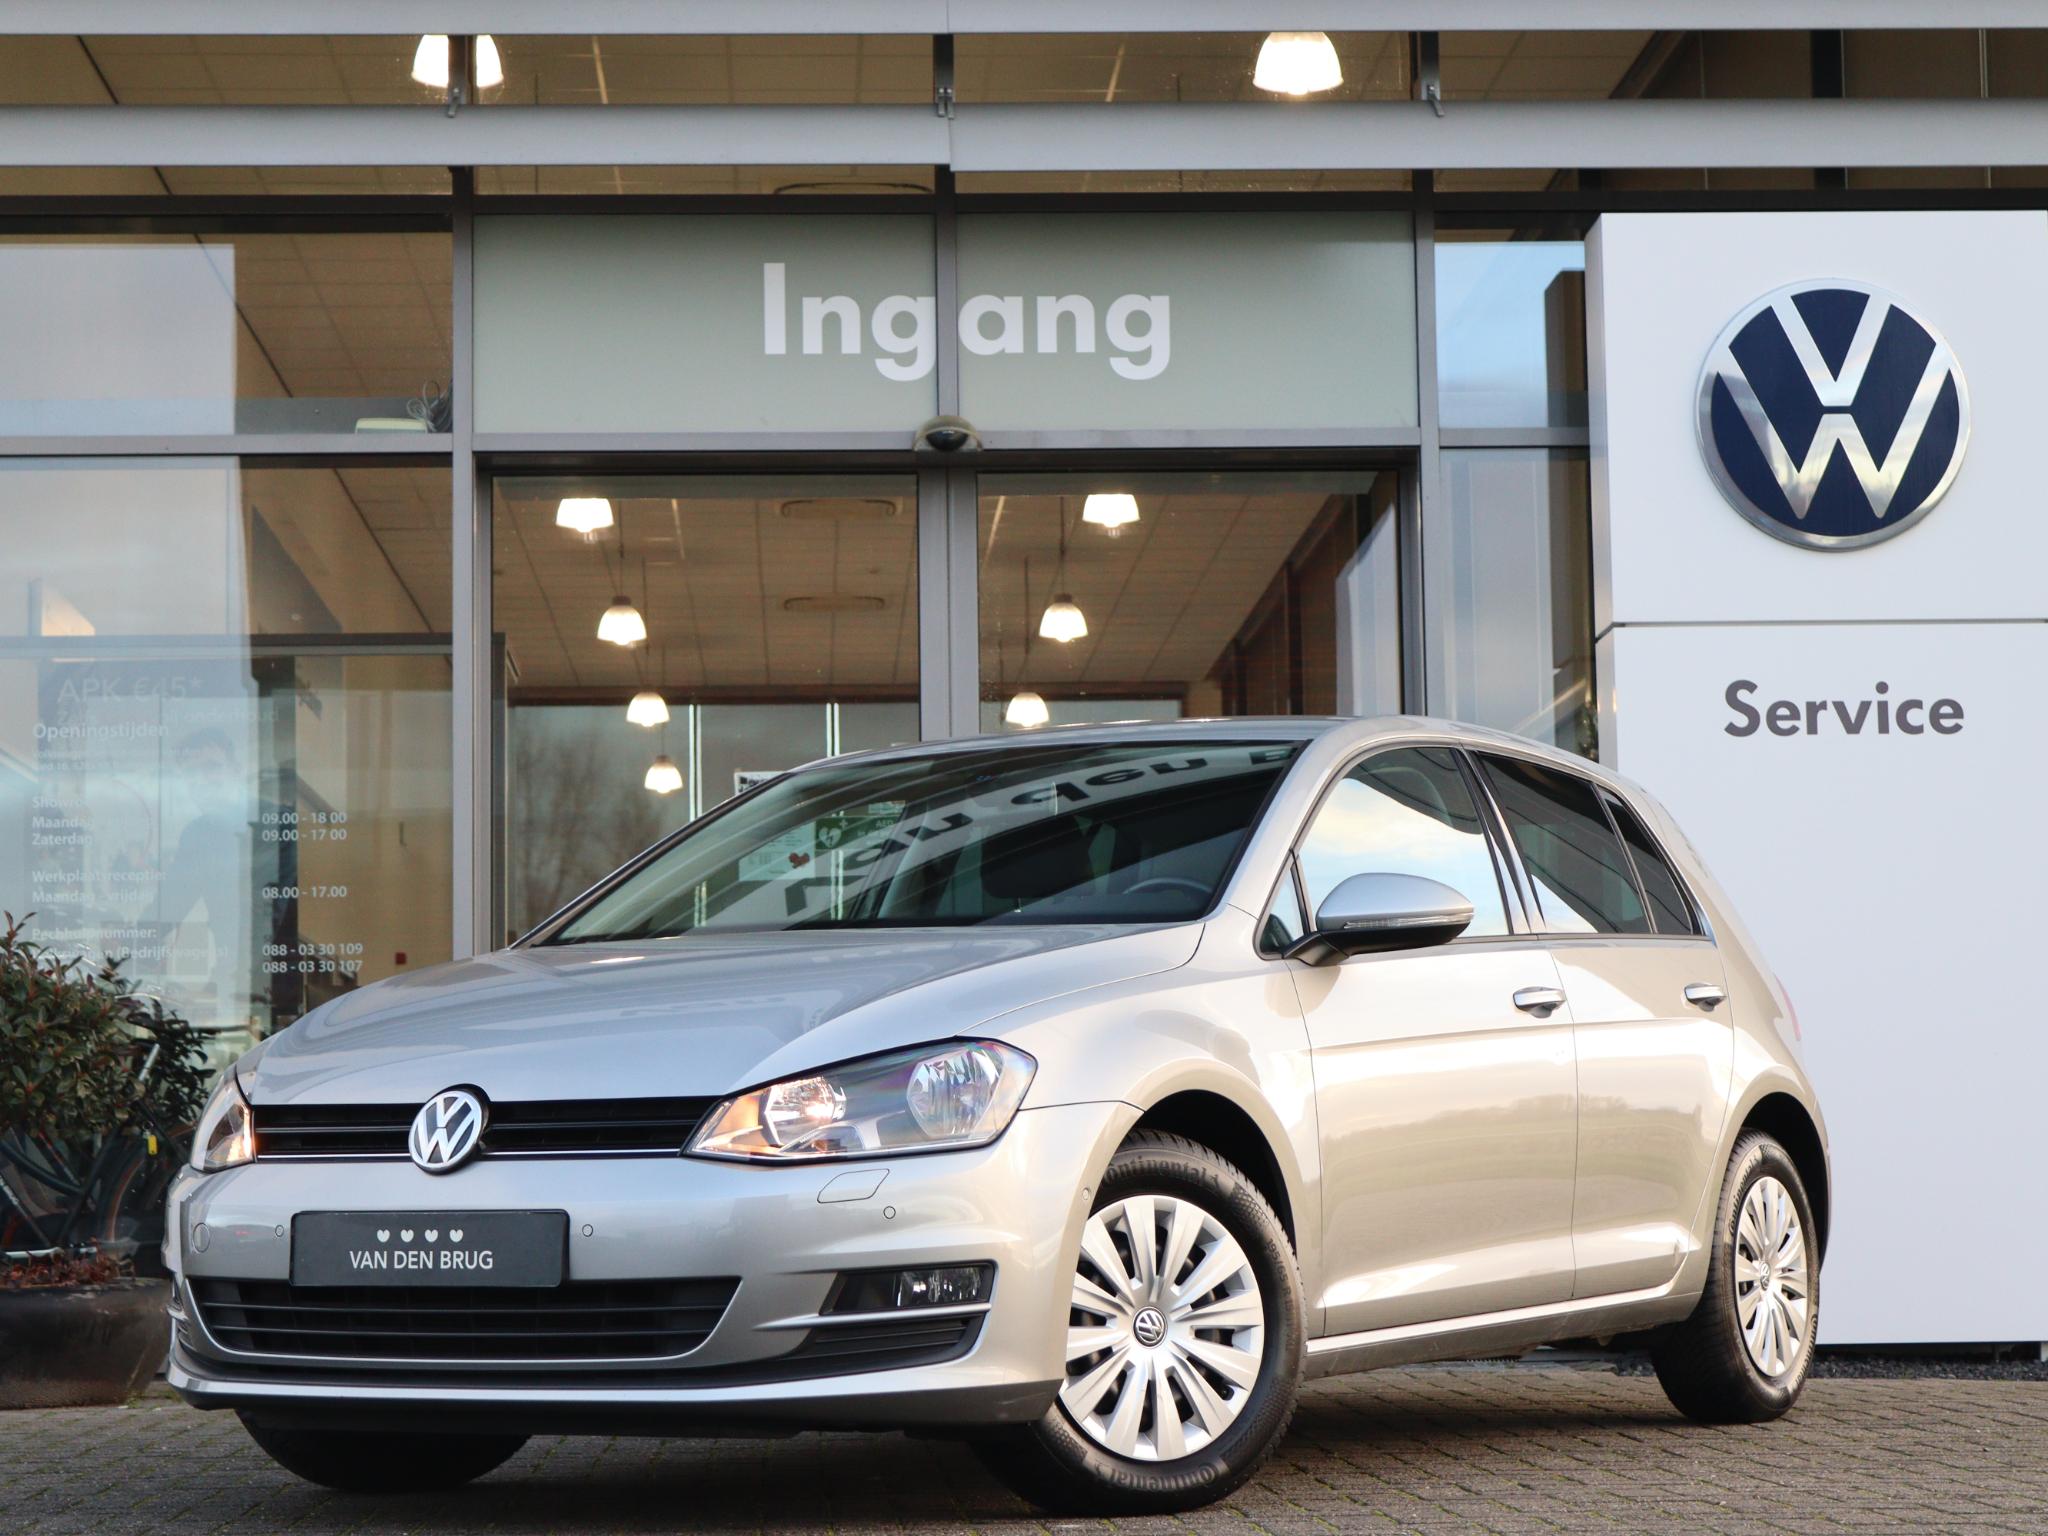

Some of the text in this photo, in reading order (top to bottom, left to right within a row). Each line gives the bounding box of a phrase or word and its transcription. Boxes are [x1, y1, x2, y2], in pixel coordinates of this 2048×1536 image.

[763, 262, 1171, 381] Ingang
[57, 678, 121, 703] APK
[1724, 679, 1965, 738] Service
[32, 722, 169, 742] Openingstijden
[262, 812, 299, 825] 09.00
[31, 832, 93, 849] Zaterdag
[262, 829, 299, 842] 09.00
[262, 886, 299, 899] 08.00
[312, 885, 348, 898] 17.00
[262, 944, 288, 956] 088
[298, 943, 315, 955] 03
[319, 943, 336, 955] 30
[340, 943, 364, 955] 109
[262, 961, 288, 973] 088
[298, 961, 315, 973] 03
[319, 961, 336, 973] 30
[340, 960, 363, 972] 107
[350, 1250, 493, 1269] VAN DEN BRUG
